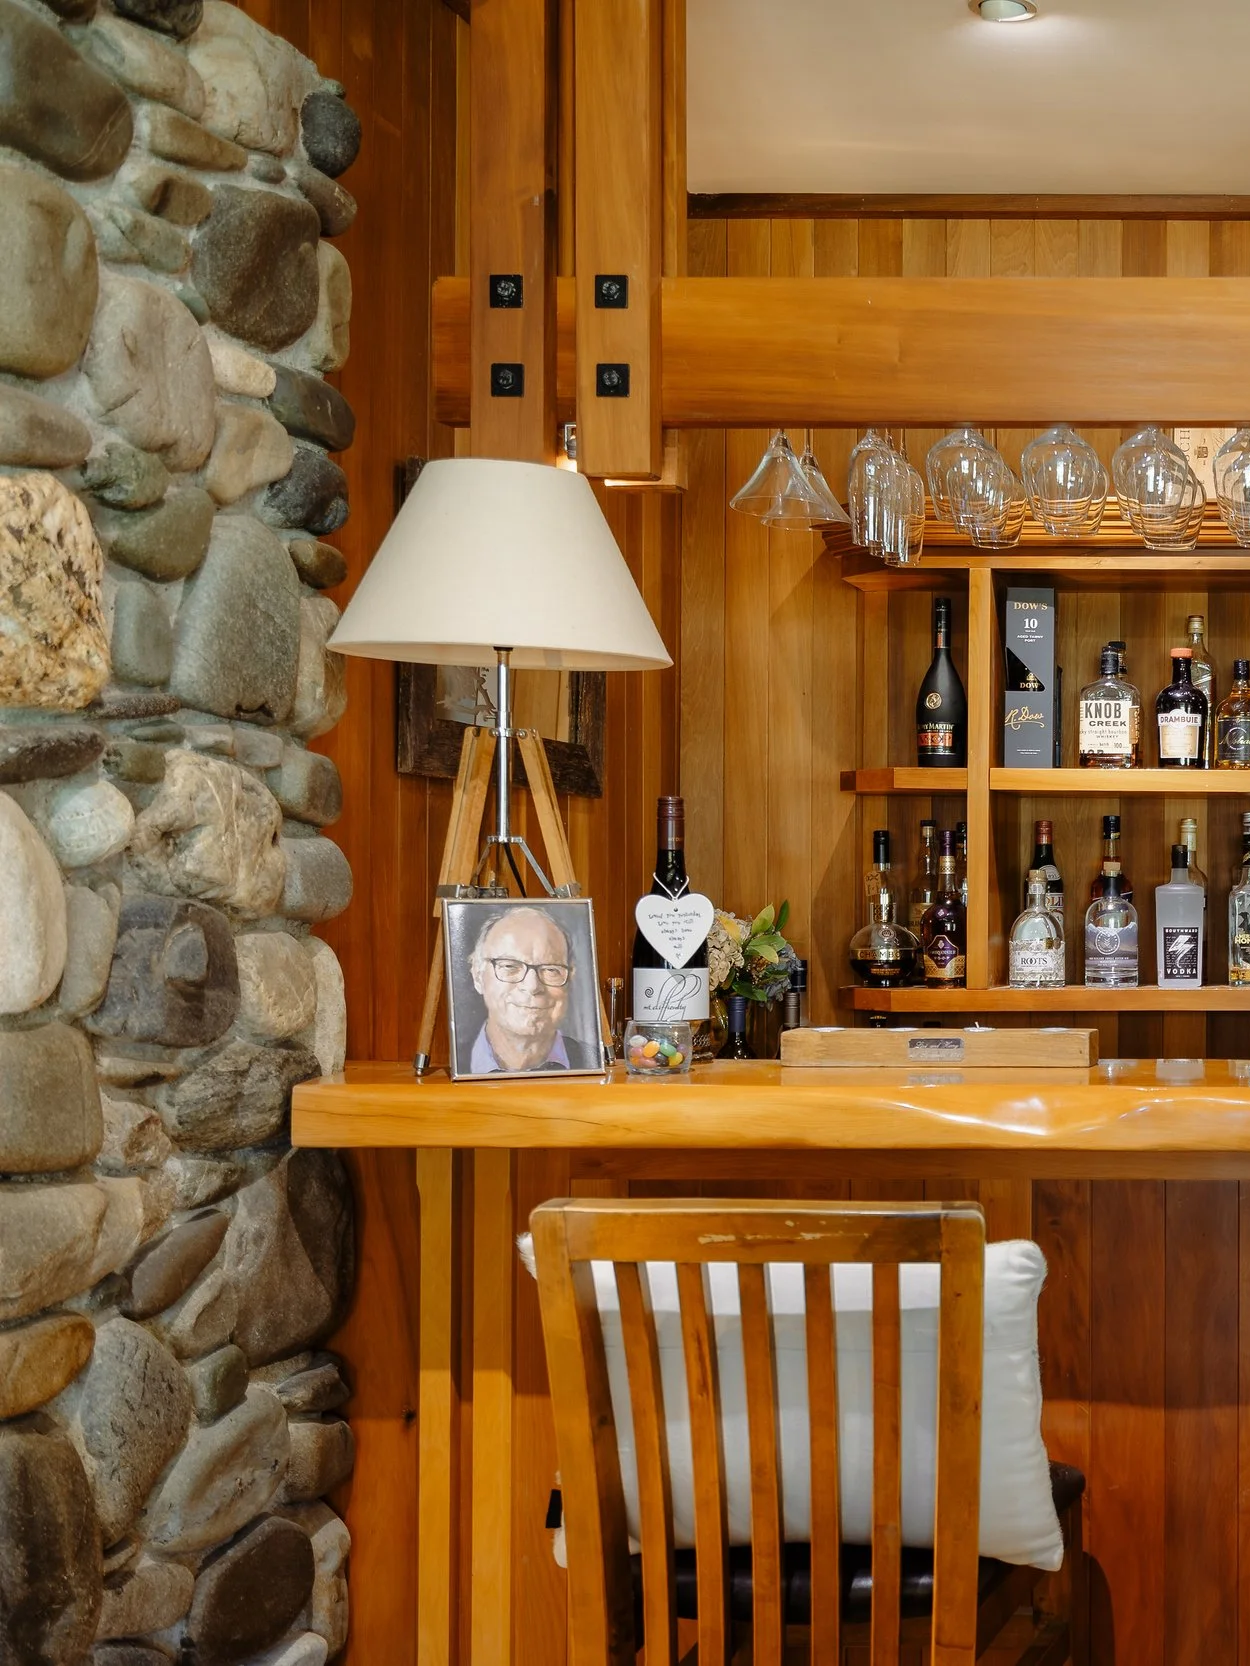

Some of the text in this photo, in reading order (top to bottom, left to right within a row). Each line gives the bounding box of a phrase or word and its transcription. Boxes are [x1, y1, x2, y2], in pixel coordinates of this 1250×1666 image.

[1014, 602, 1048, 611] DOW'S
[1023, 618, 1038, 629] 10
[1085, 703, 1122, 719] KNOB
[1160, 716, 1199, 724] DRAMBUIE
[1021, 957, 1048, 965] ROOTS
